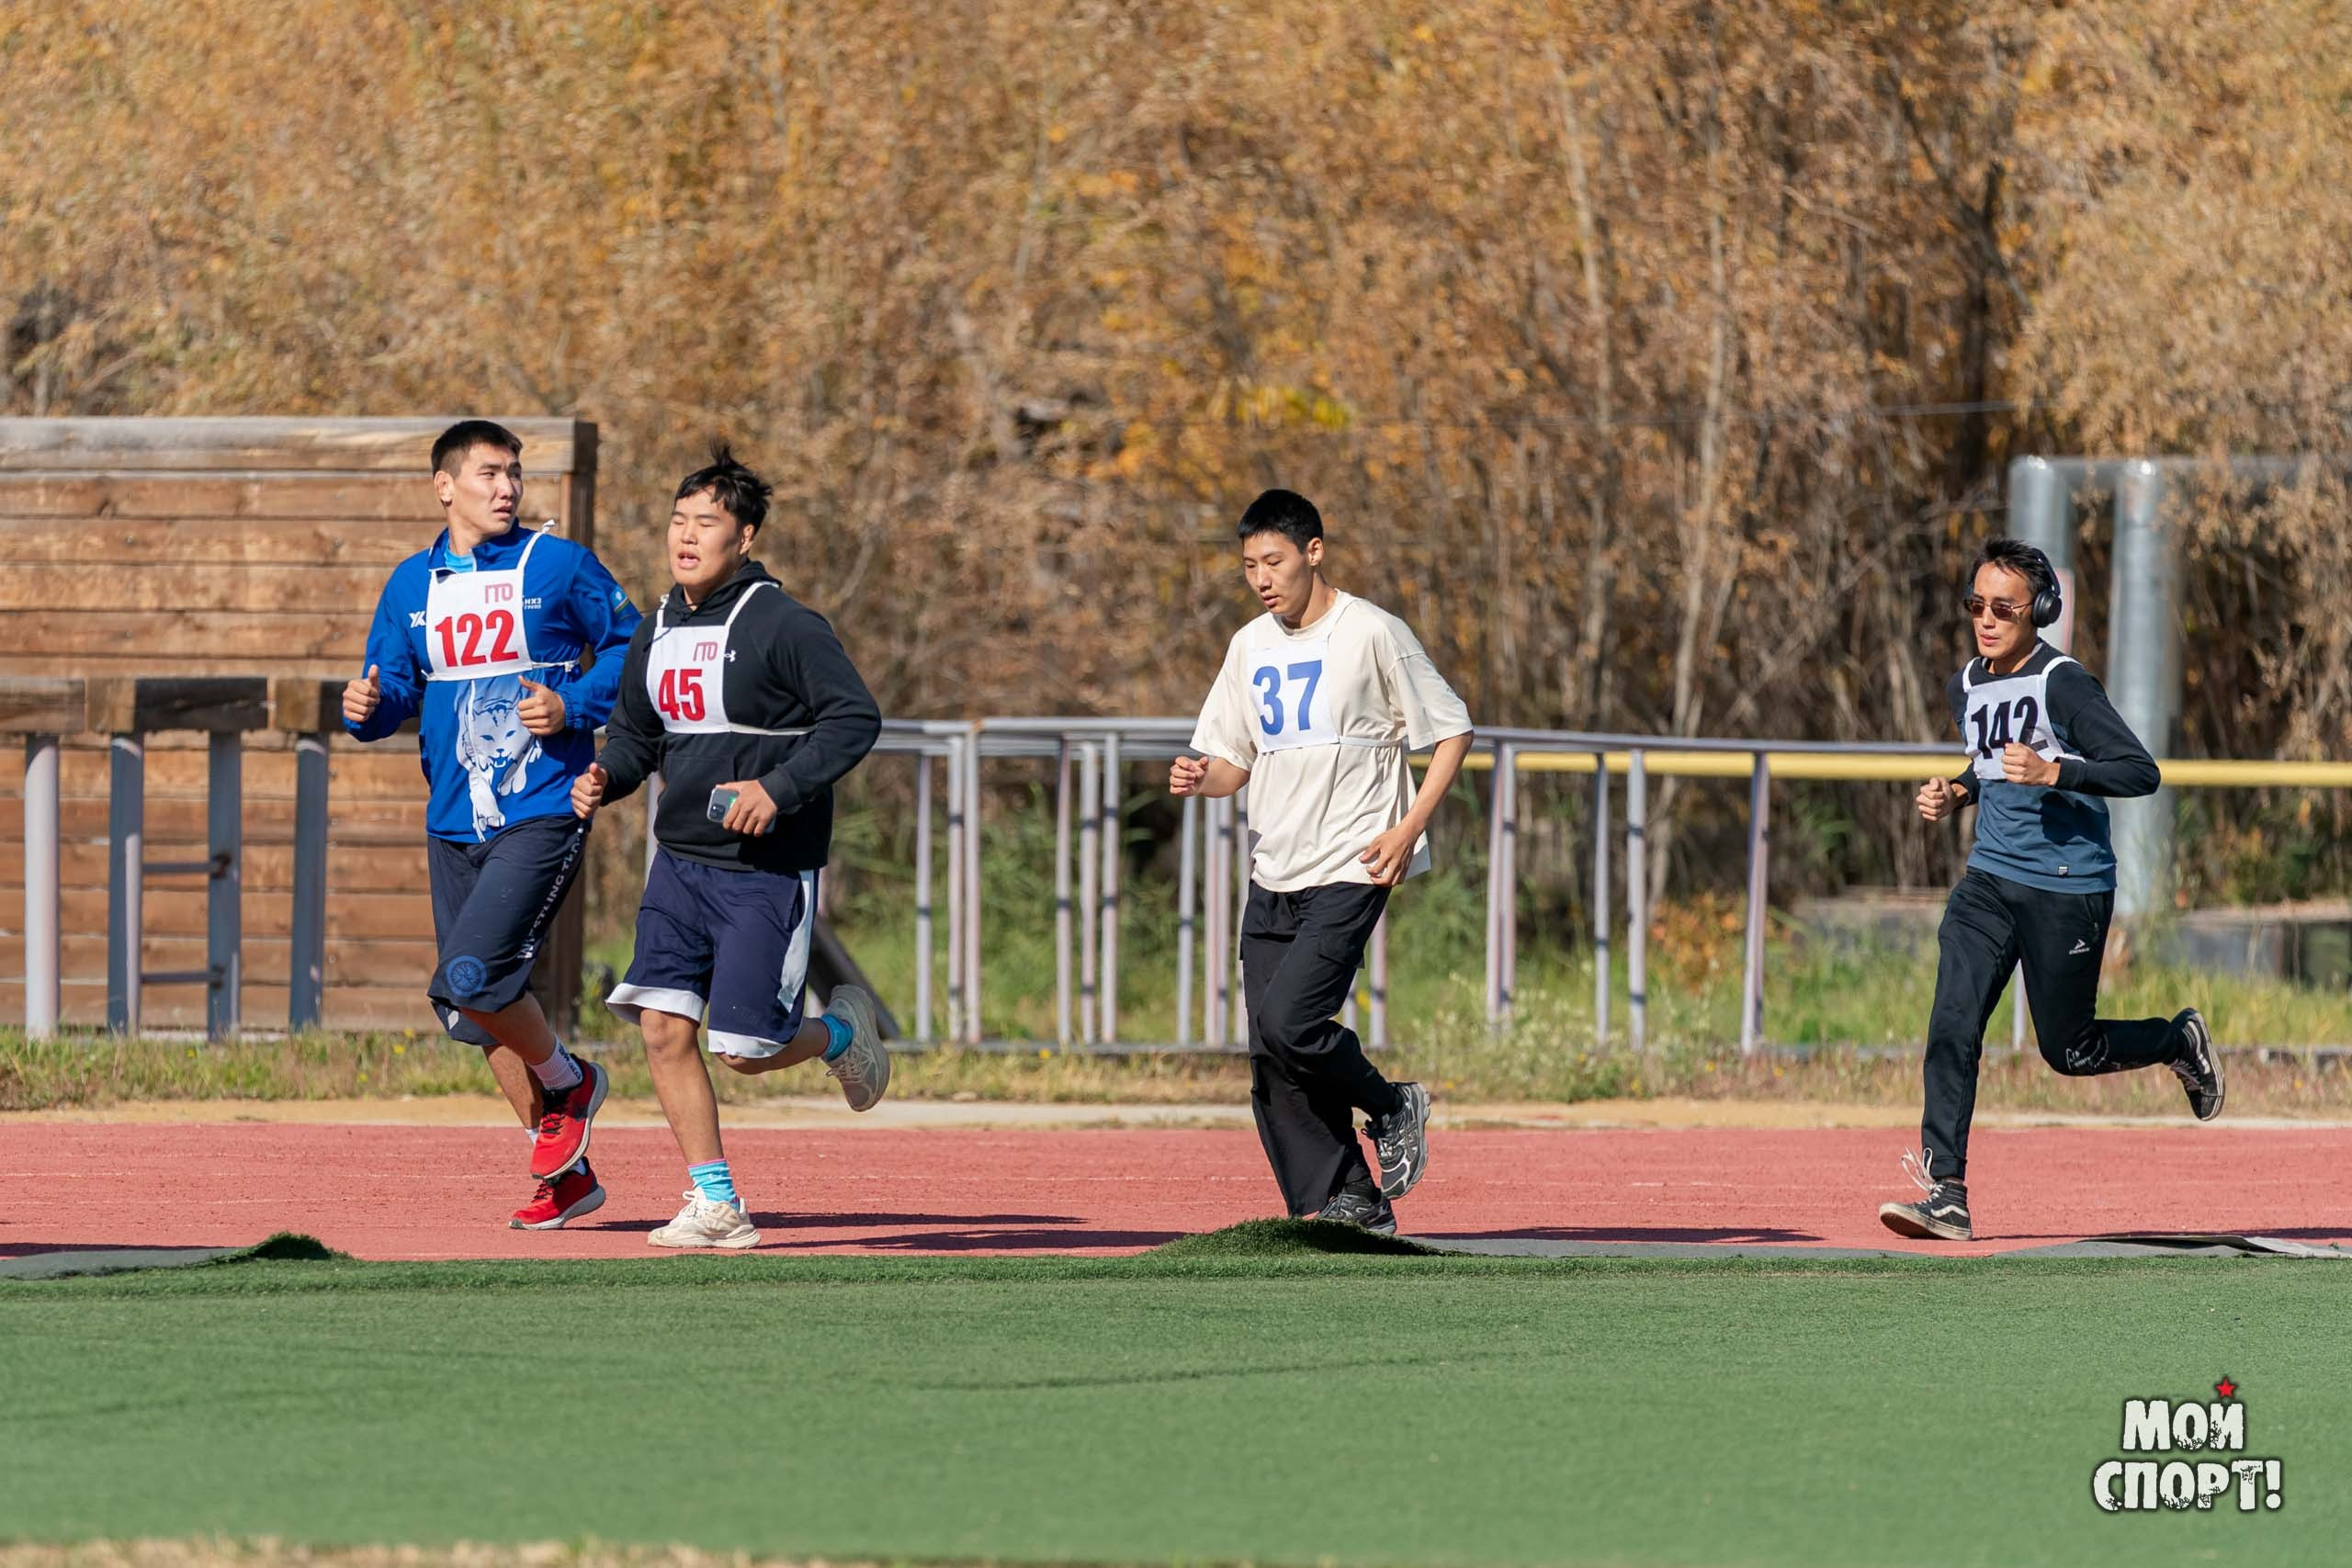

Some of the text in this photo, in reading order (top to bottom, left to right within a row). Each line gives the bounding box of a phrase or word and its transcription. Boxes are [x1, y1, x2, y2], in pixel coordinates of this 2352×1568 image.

[484, 582, 514, 604] ГТО
[435, 609, 519, 668] 122
[693, 641, 718, 662] ГТО
[658, 669, 706, 722] 45
[1252, 659, 1323, 736] 37
[1971, 695, 2049, 760] 142
